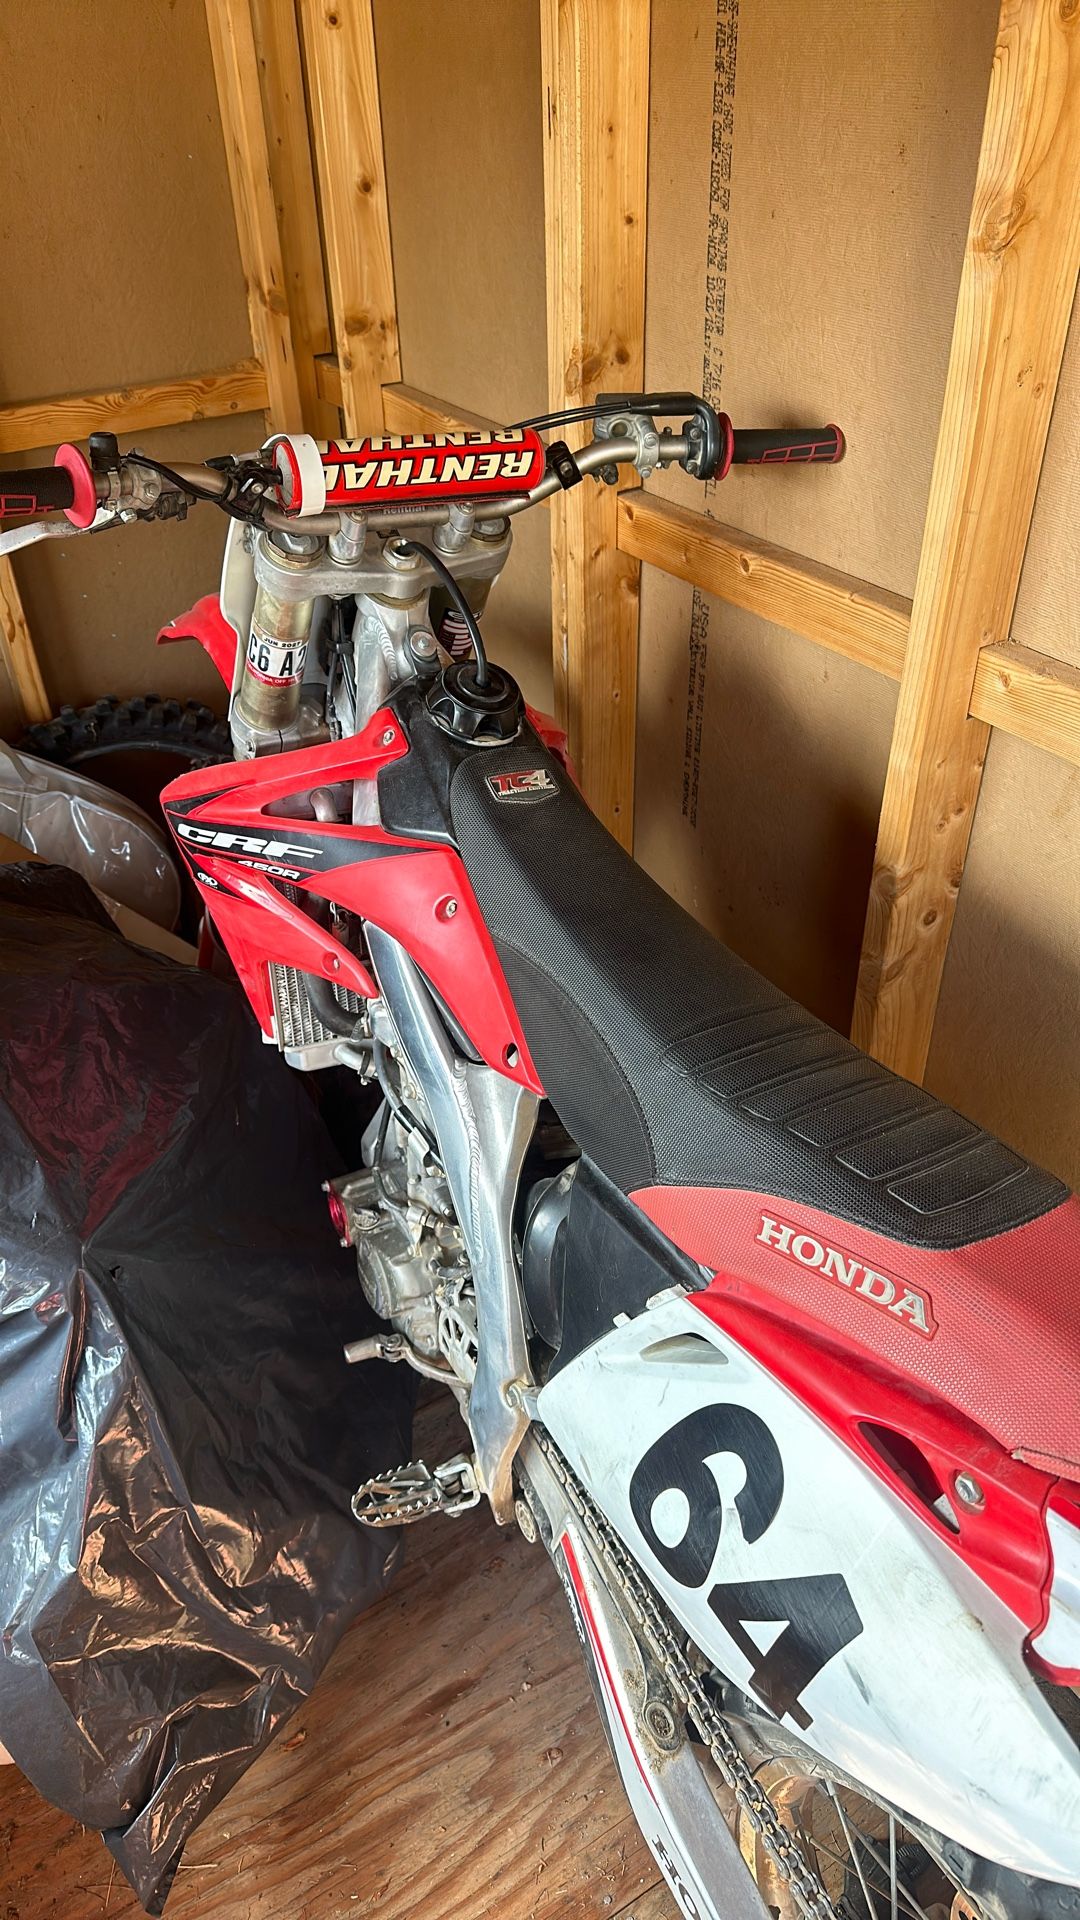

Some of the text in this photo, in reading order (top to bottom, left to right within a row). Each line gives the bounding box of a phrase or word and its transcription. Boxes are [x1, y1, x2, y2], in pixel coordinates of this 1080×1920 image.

[177, 823, 324, 859] CRF
[238, 860, 301, 880] 450R
[756, 1216, 929, 1333] HONDA
[629, 1403, 864, 1731] 64
